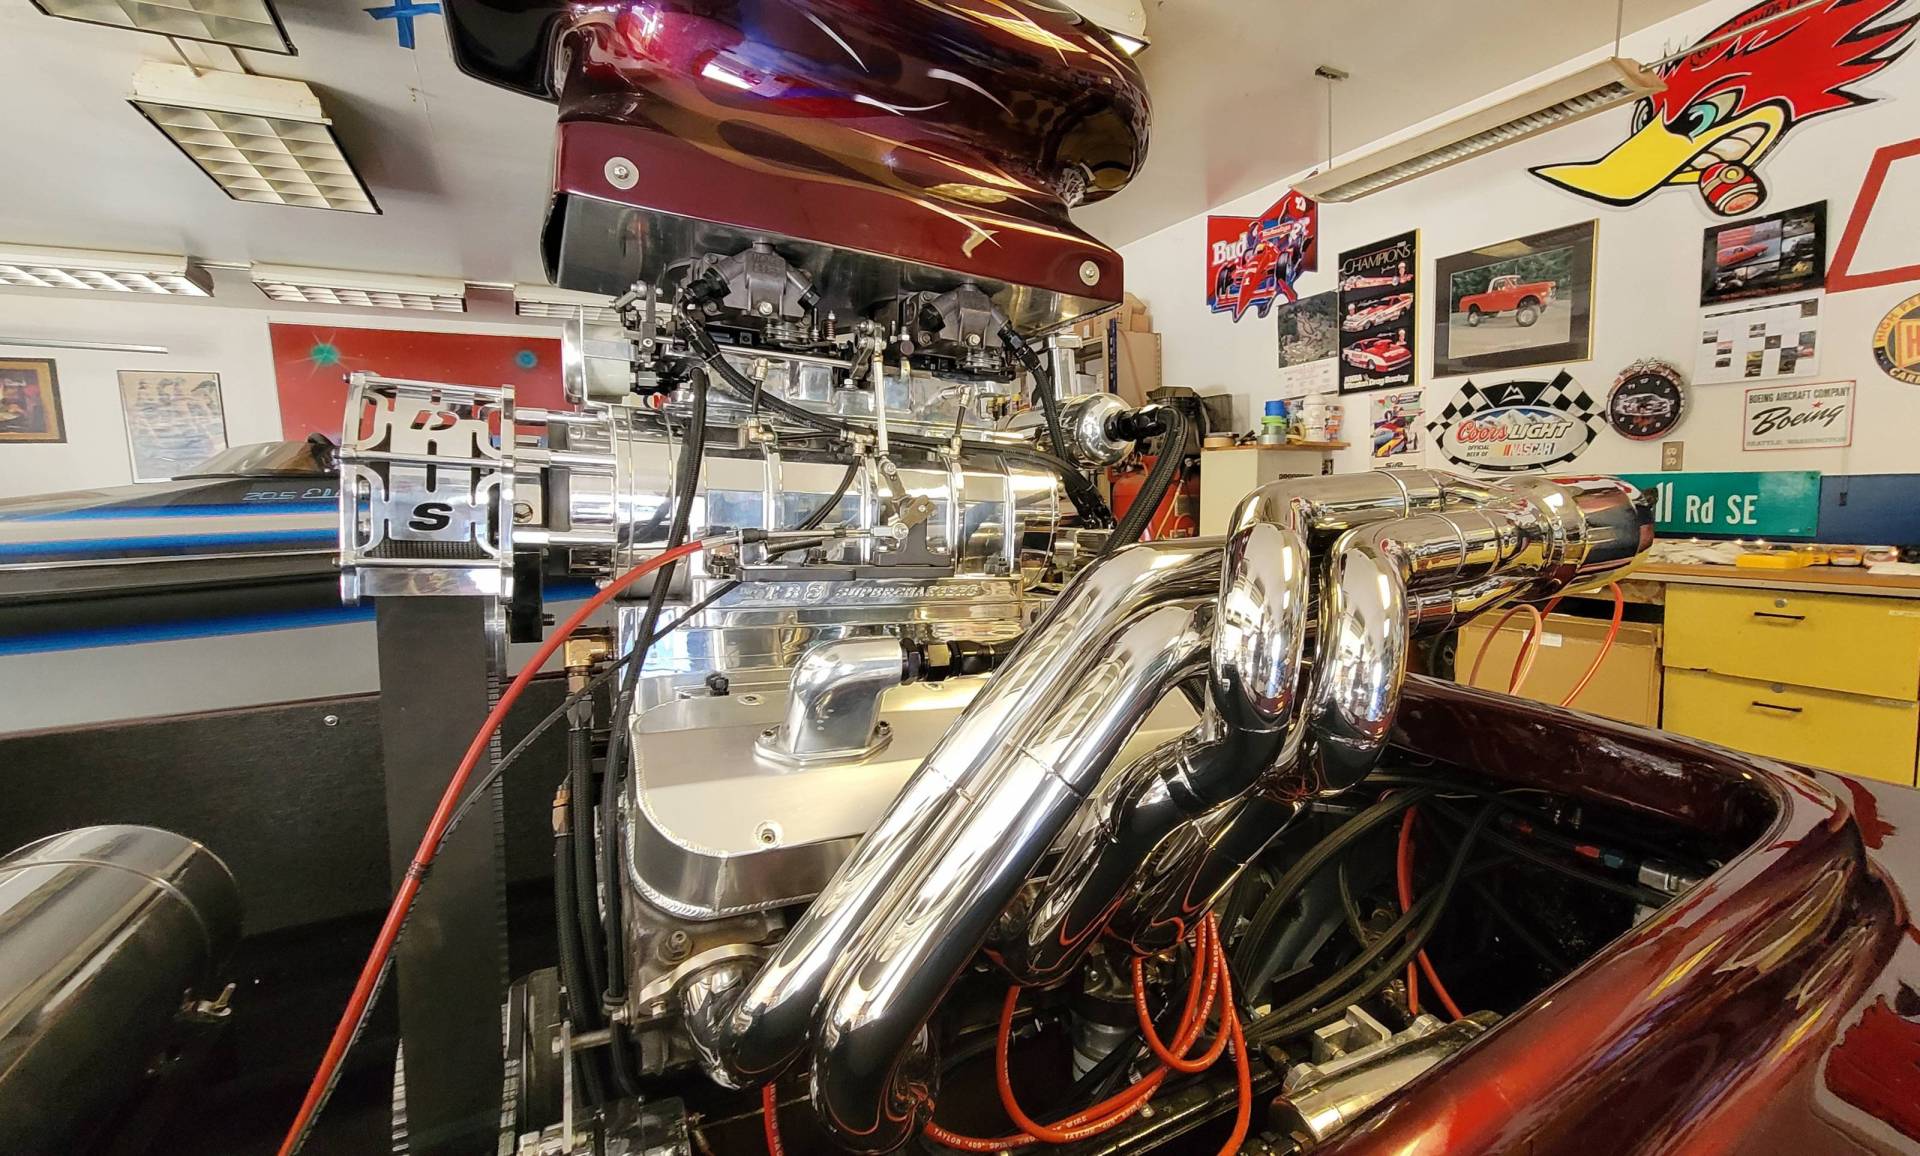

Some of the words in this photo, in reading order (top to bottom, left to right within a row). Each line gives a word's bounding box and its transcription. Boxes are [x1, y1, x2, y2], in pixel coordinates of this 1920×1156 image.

[1212, 232, 1249, 266] Bud
[1344, 244, 1411, 275] CHAMPIONS
[1748, 393, 1774, 404] BOEING
[1776, 389, 1812, 402] AIRCRAFT
[1813, 386, 1850, 399] COMPANY
[1751, 404, 1845, 436] Boeing
[1456, 419, 1508, 443] Coors
[1507, 421, 1573, 441] LIGHT
[1506, 442, 1556, 457] NASCAR
[242, 491, 297, 501] 205
[1686, 495, 1714, 523] Rd
[1726, 495, 1758, 524] SE
[1210, 972, 1218, 990] PRO
[934, 1128, 961, 1145] TAYLOR
